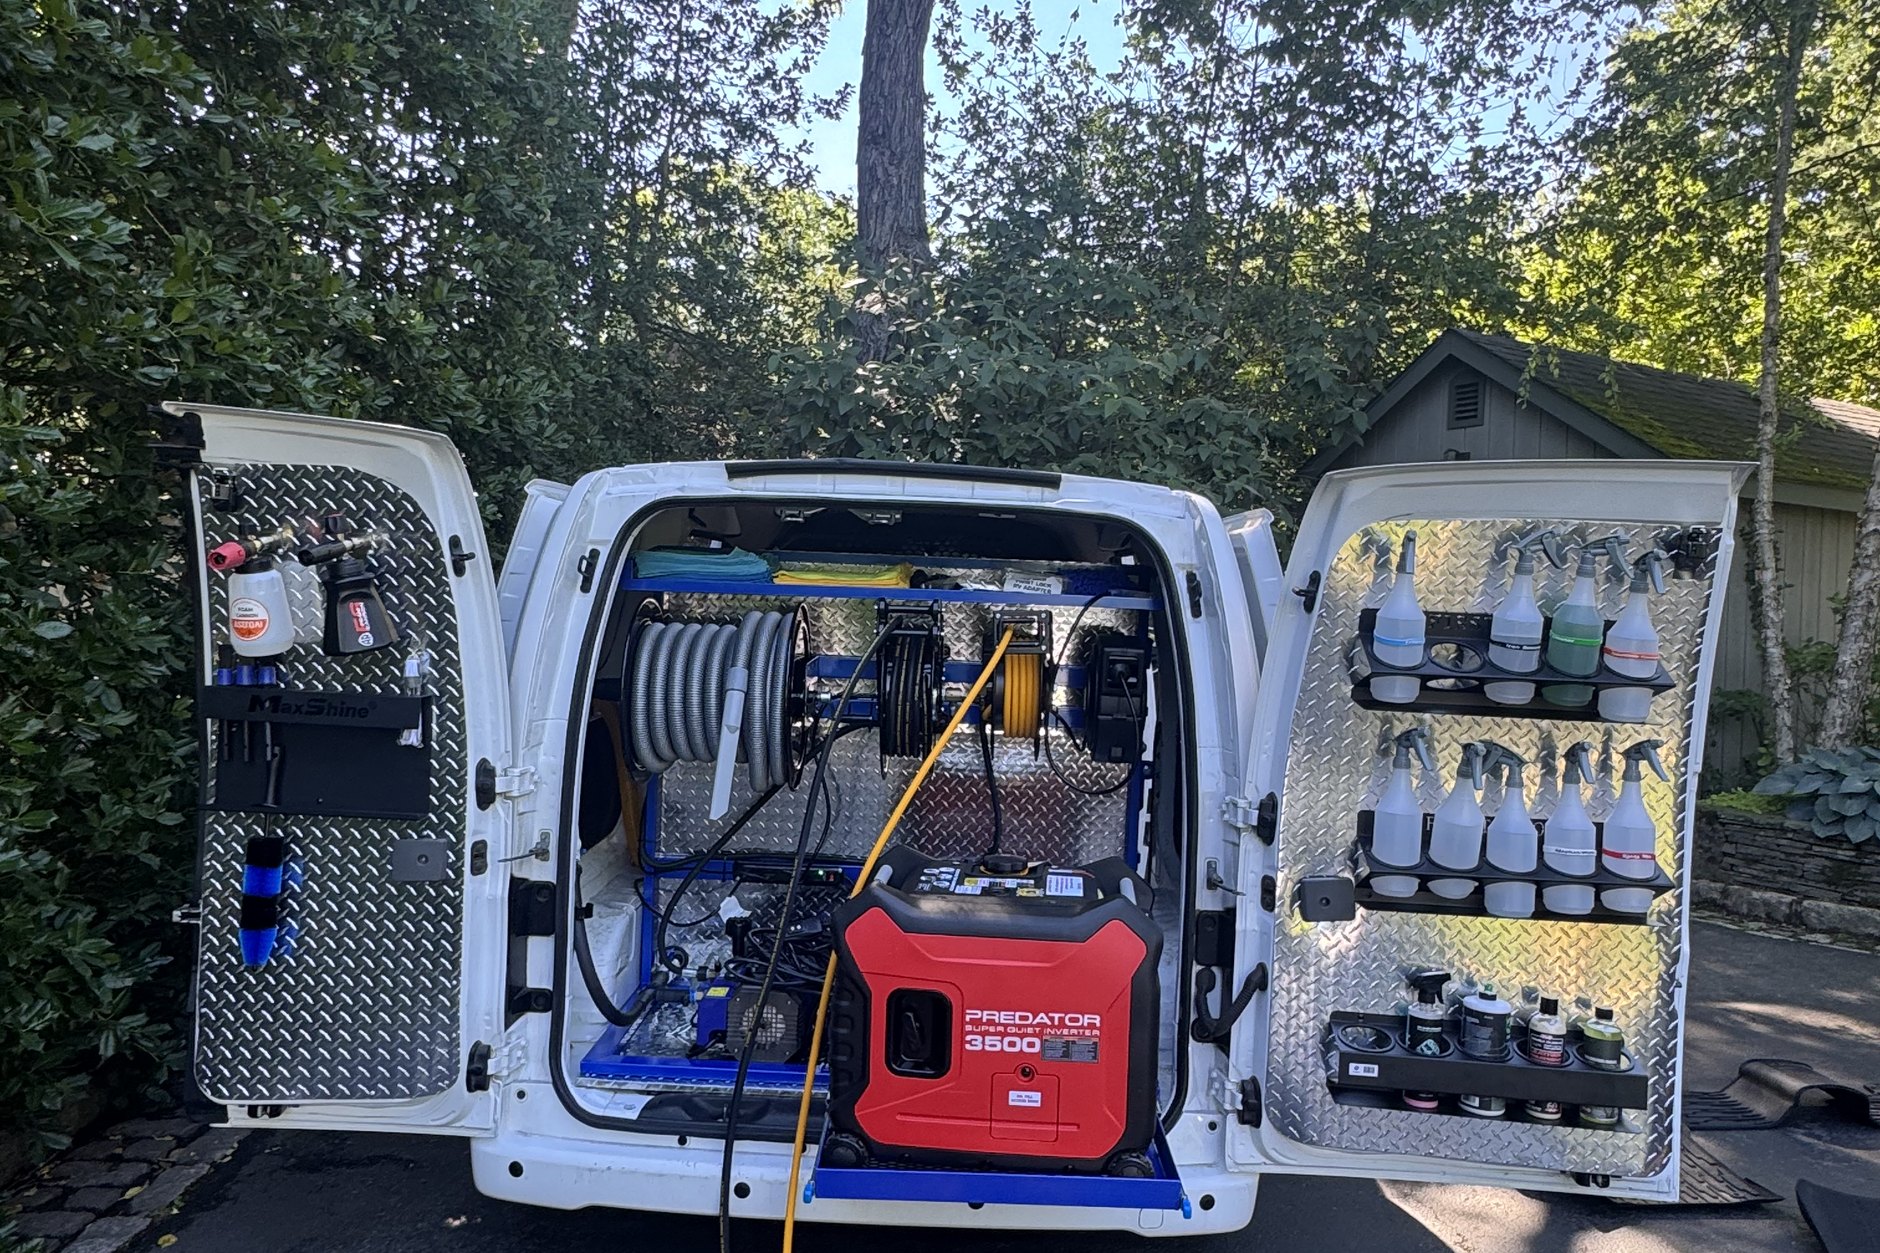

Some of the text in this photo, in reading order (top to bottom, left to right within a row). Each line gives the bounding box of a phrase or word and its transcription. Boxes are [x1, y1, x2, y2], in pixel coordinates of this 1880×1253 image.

[965, 1009, 1101, 1027] PREDATOR
[965, 1025, 1100, 1036] SUPER QUIET INVERTER
[965, 1034, 1041, 1053] 3500
